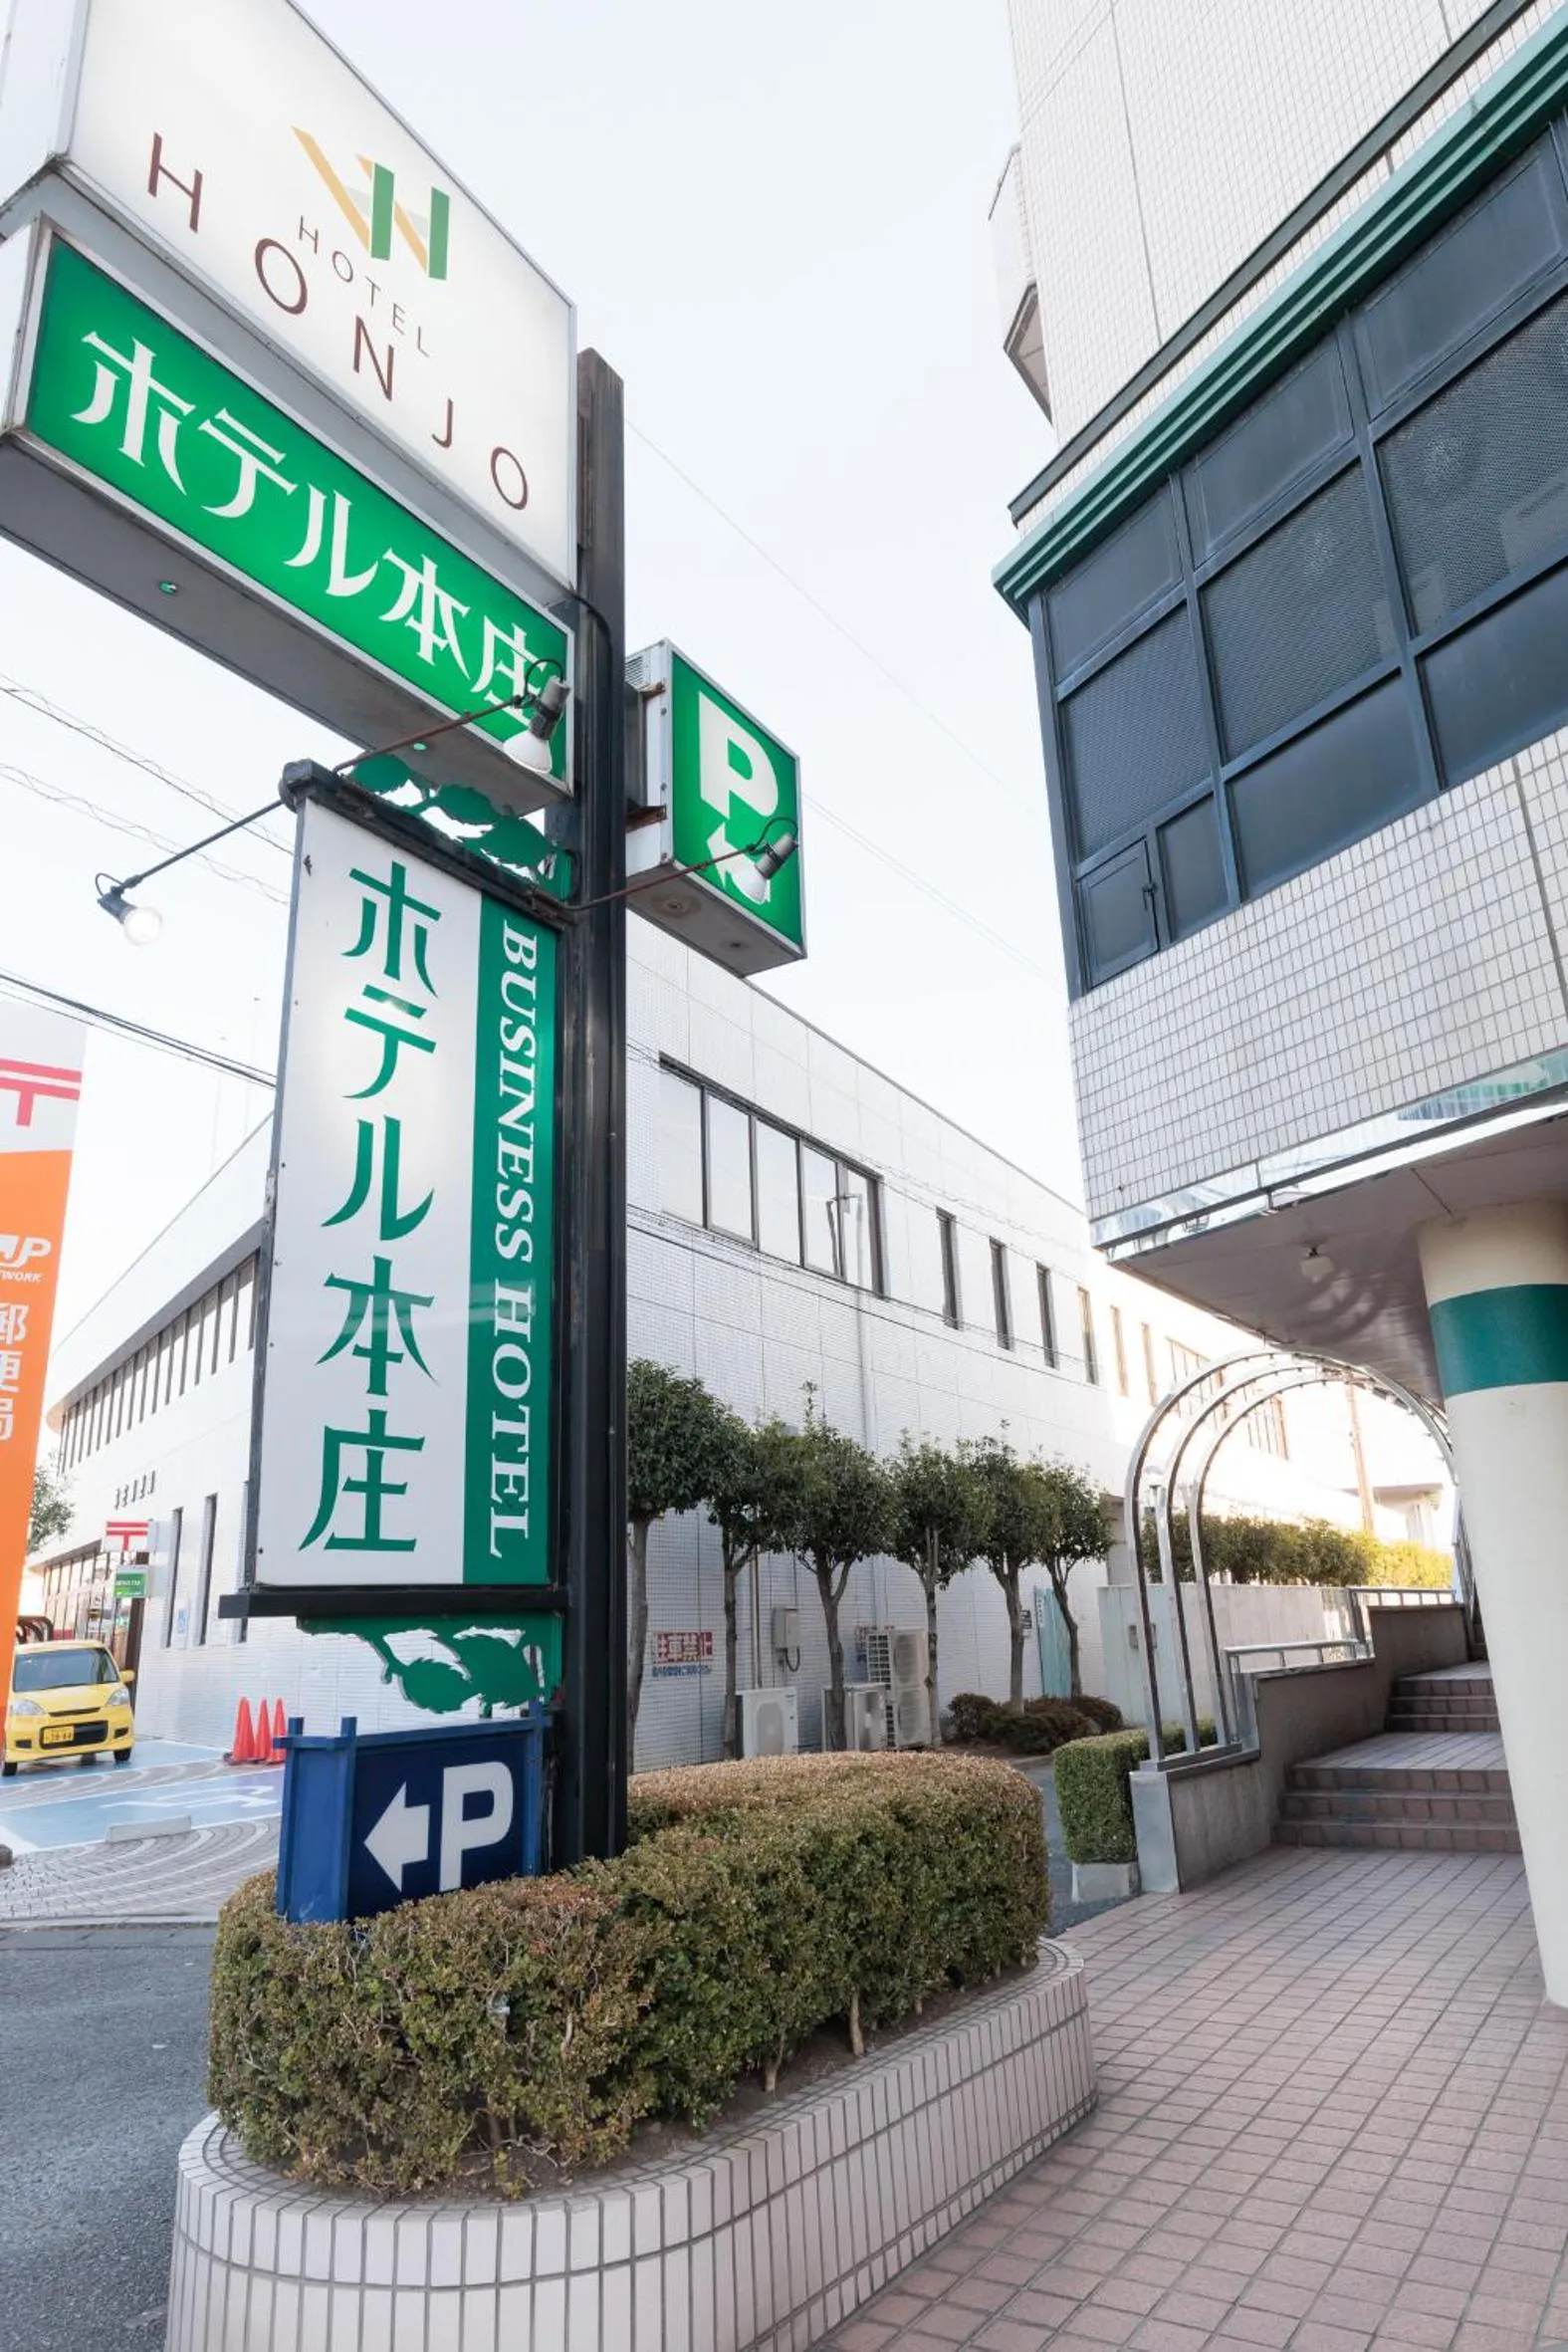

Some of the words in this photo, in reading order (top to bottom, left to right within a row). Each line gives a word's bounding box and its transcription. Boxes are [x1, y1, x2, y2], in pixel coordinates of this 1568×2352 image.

[147, 131, 528, 511] HONJO
[299, 215, 430, 358] HOTEL
[71, 331, 548, 728] ホテル本庄
[698, 690, 779, 820] P
[298, 860, 441, 1552] ホテル本庄
[495, 919, 539, 1264] BUSINESS
[490, 1279, 533, 1558] HOTEL
[439, 1761, 514, 1892] P
